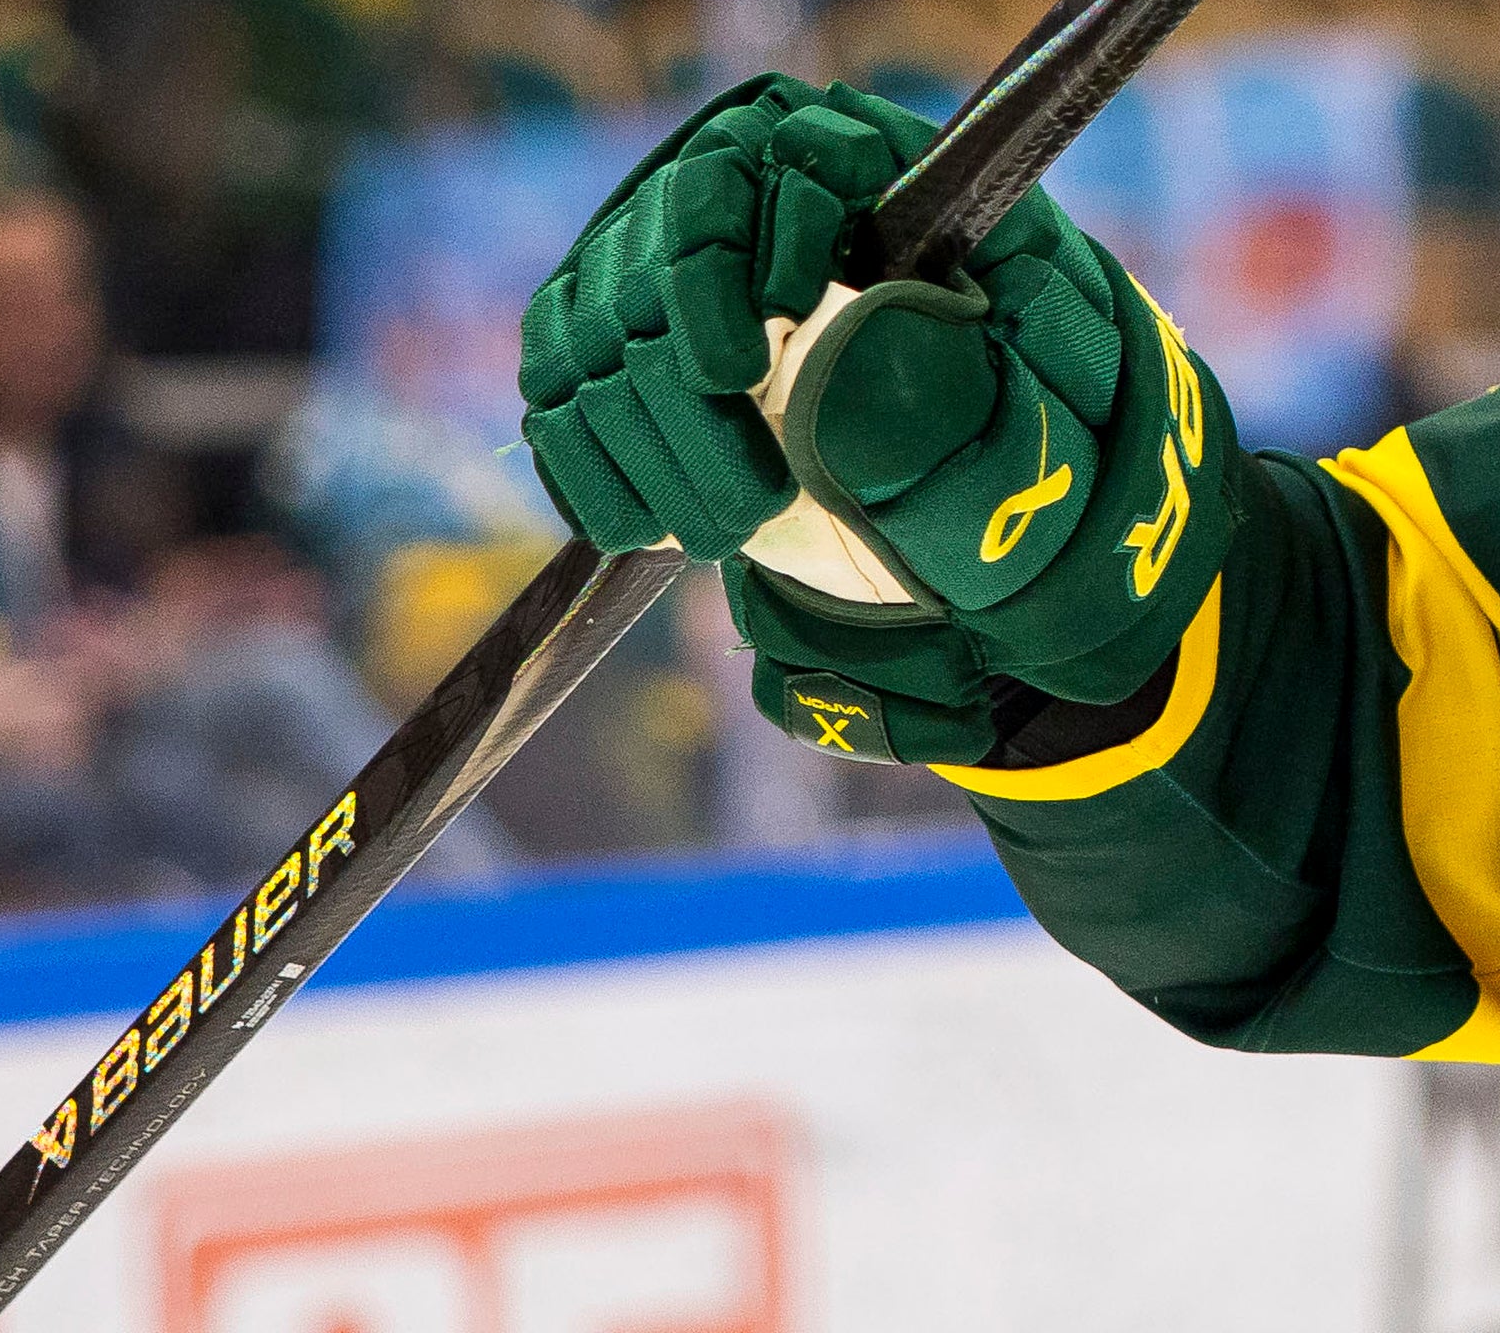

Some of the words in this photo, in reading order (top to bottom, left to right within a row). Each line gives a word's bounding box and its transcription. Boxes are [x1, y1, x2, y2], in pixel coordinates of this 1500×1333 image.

[91, 789, 357, 1137] BAUER
[25, 1200, 89, 1260] TAPER
[85, 1068, 208, 1194] TECHNOLOGY
